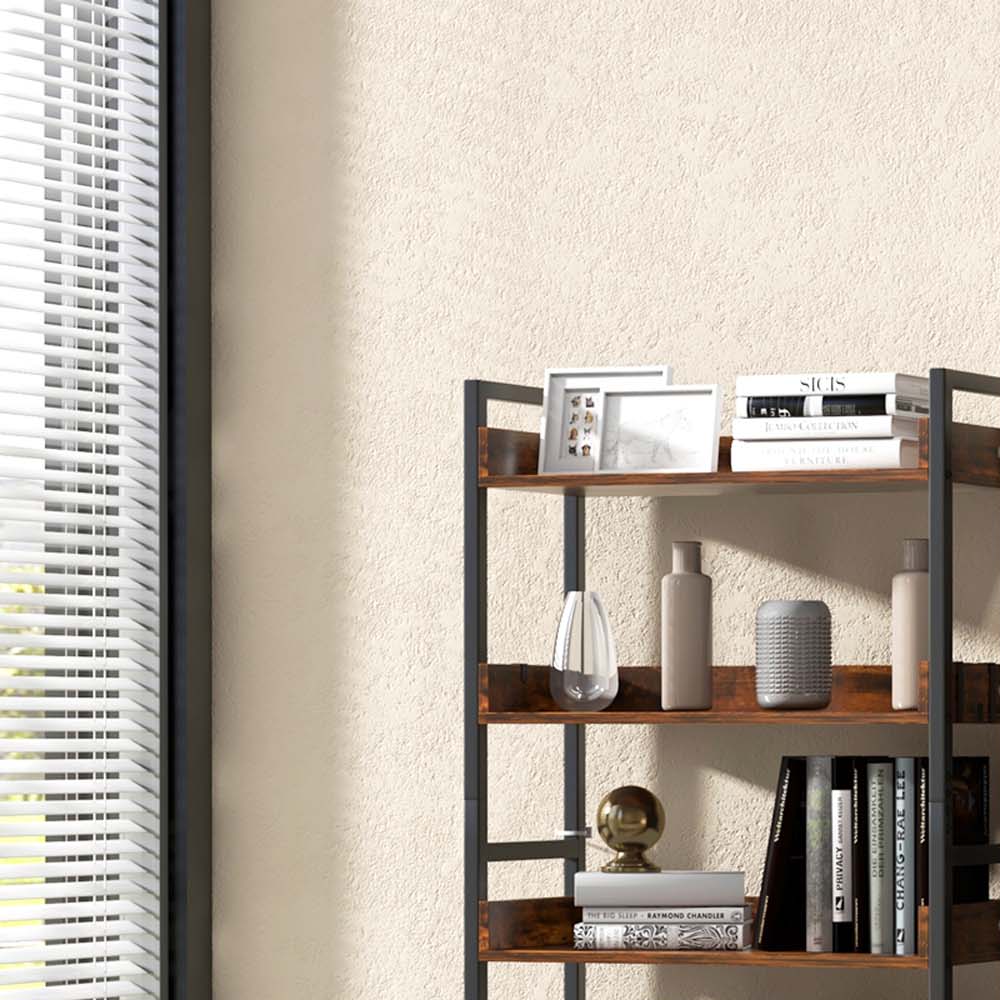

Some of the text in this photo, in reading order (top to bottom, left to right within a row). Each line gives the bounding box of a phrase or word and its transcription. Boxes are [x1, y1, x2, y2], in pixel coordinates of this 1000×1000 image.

[801, 377, 846, 391] SICIS
[896, 769, 905, 911] CHANG-RAE LEE
[836, 847, 844, 891] PRIVACY
